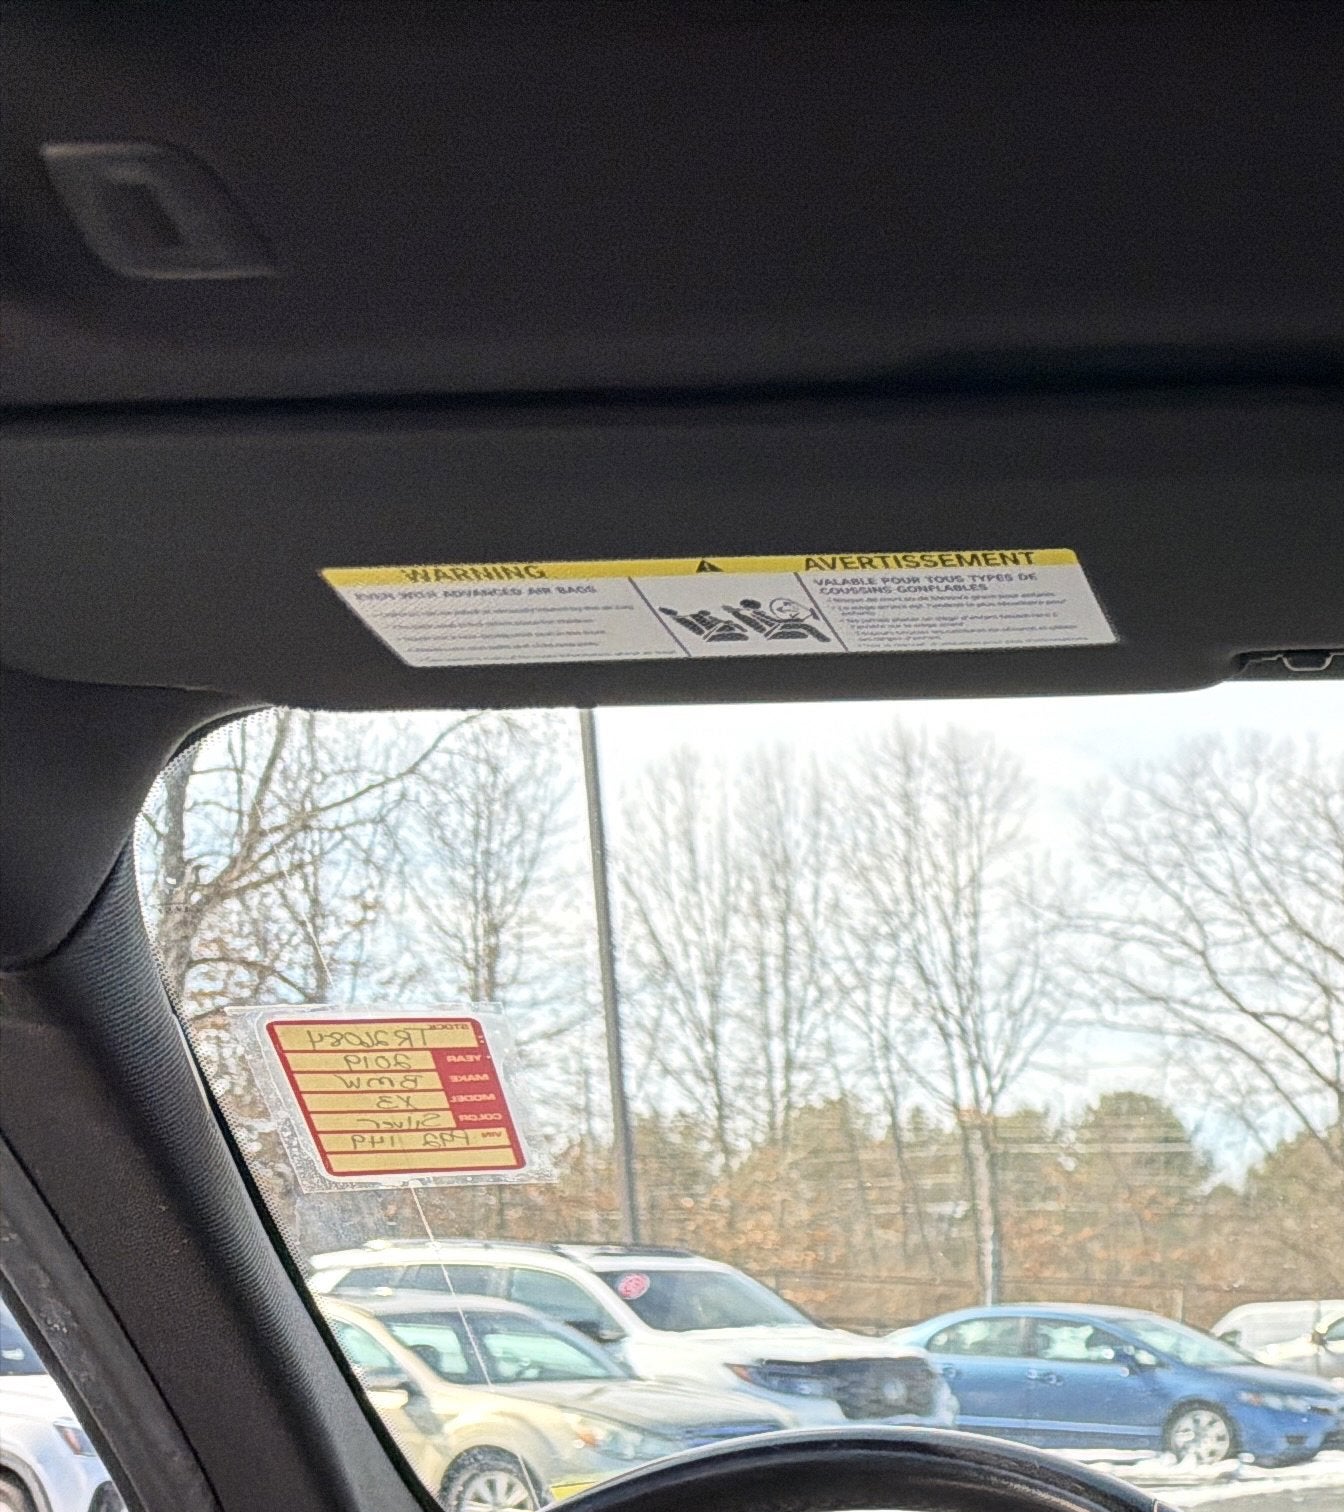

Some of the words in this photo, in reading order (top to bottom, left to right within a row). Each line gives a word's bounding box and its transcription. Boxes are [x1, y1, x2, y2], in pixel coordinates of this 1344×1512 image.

[804, 551, 1035, 571] AVERTISSEMENT
[401, 564, 547, 584] WARNING
[814, 577, 876, 587] VALABLE
[881, 575, 921, 586] POUR
[926, 574, 965, 584] TOUS
[819, 585, 892, 595] COUSSINS
